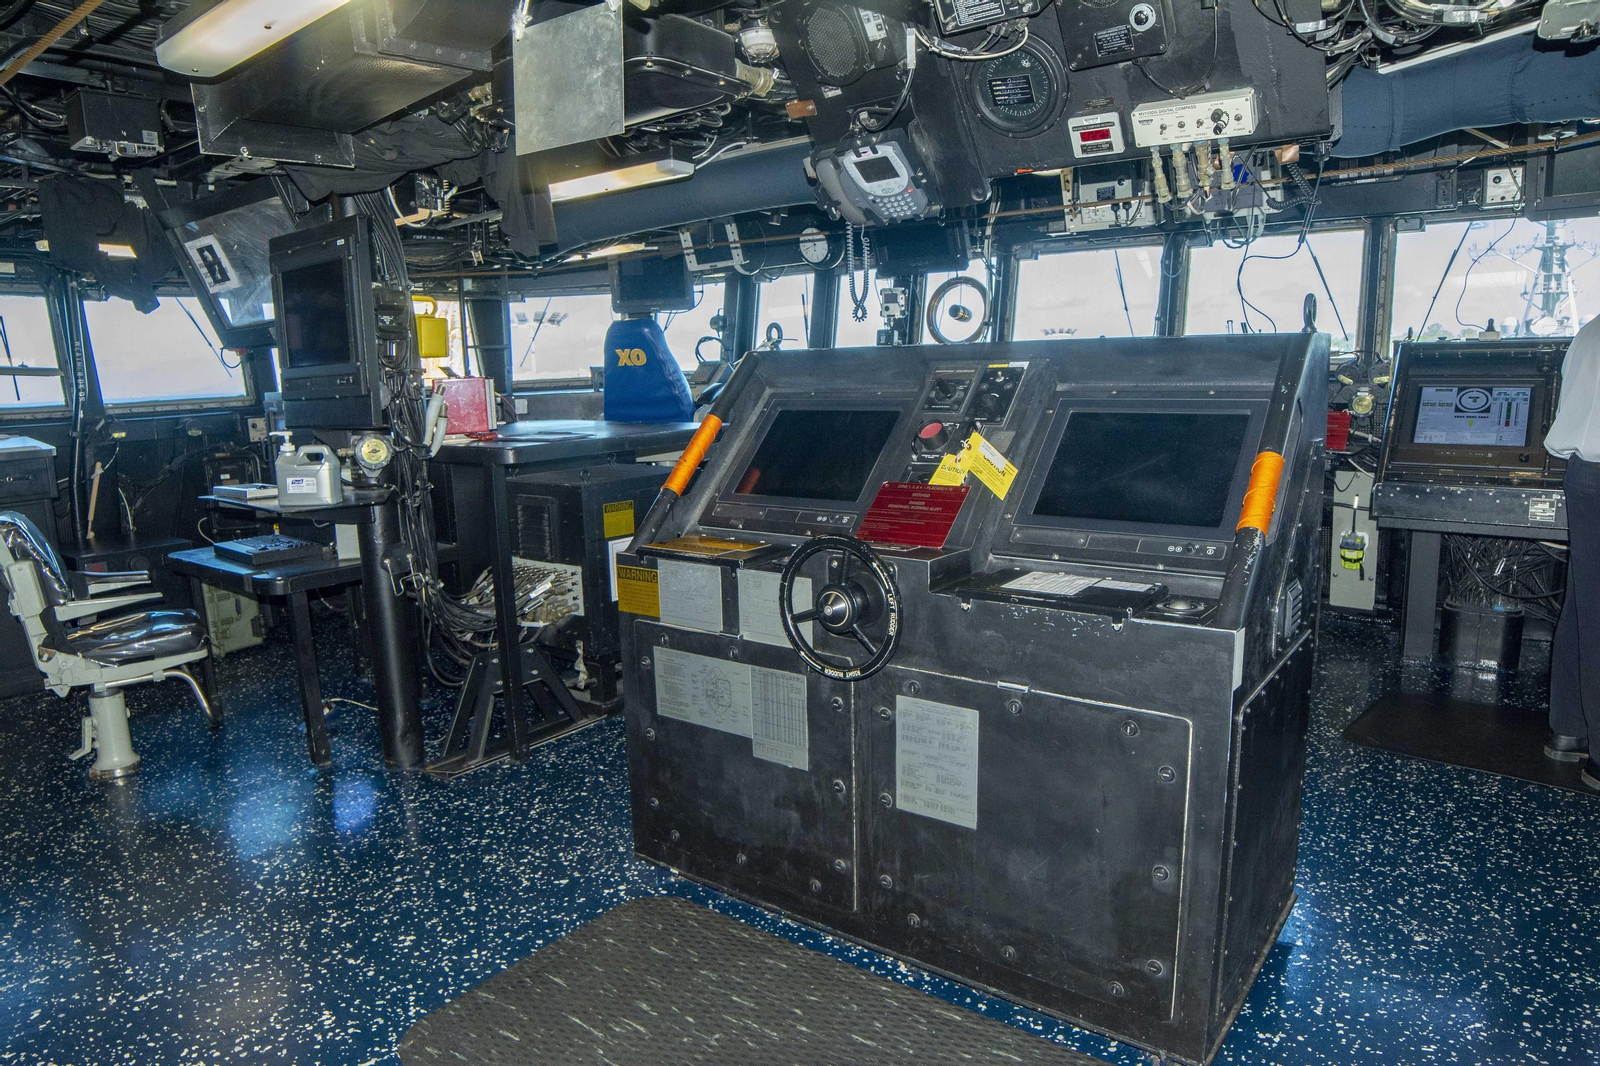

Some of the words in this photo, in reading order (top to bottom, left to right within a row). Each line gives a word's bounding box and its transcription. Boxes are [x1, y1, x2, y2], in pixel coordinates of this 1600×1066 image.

[74, 340, 83, 376] WEATHER
[615, 348, 647, 366] XO
[605, 501, 633, 512] WARNING
[618, 568, 657, 583] WARNING
[887, 593, 895, 609] LEFT
[824, 668, 843, 677] RUDDER
[846, 669, 860, 677] RIGHT
